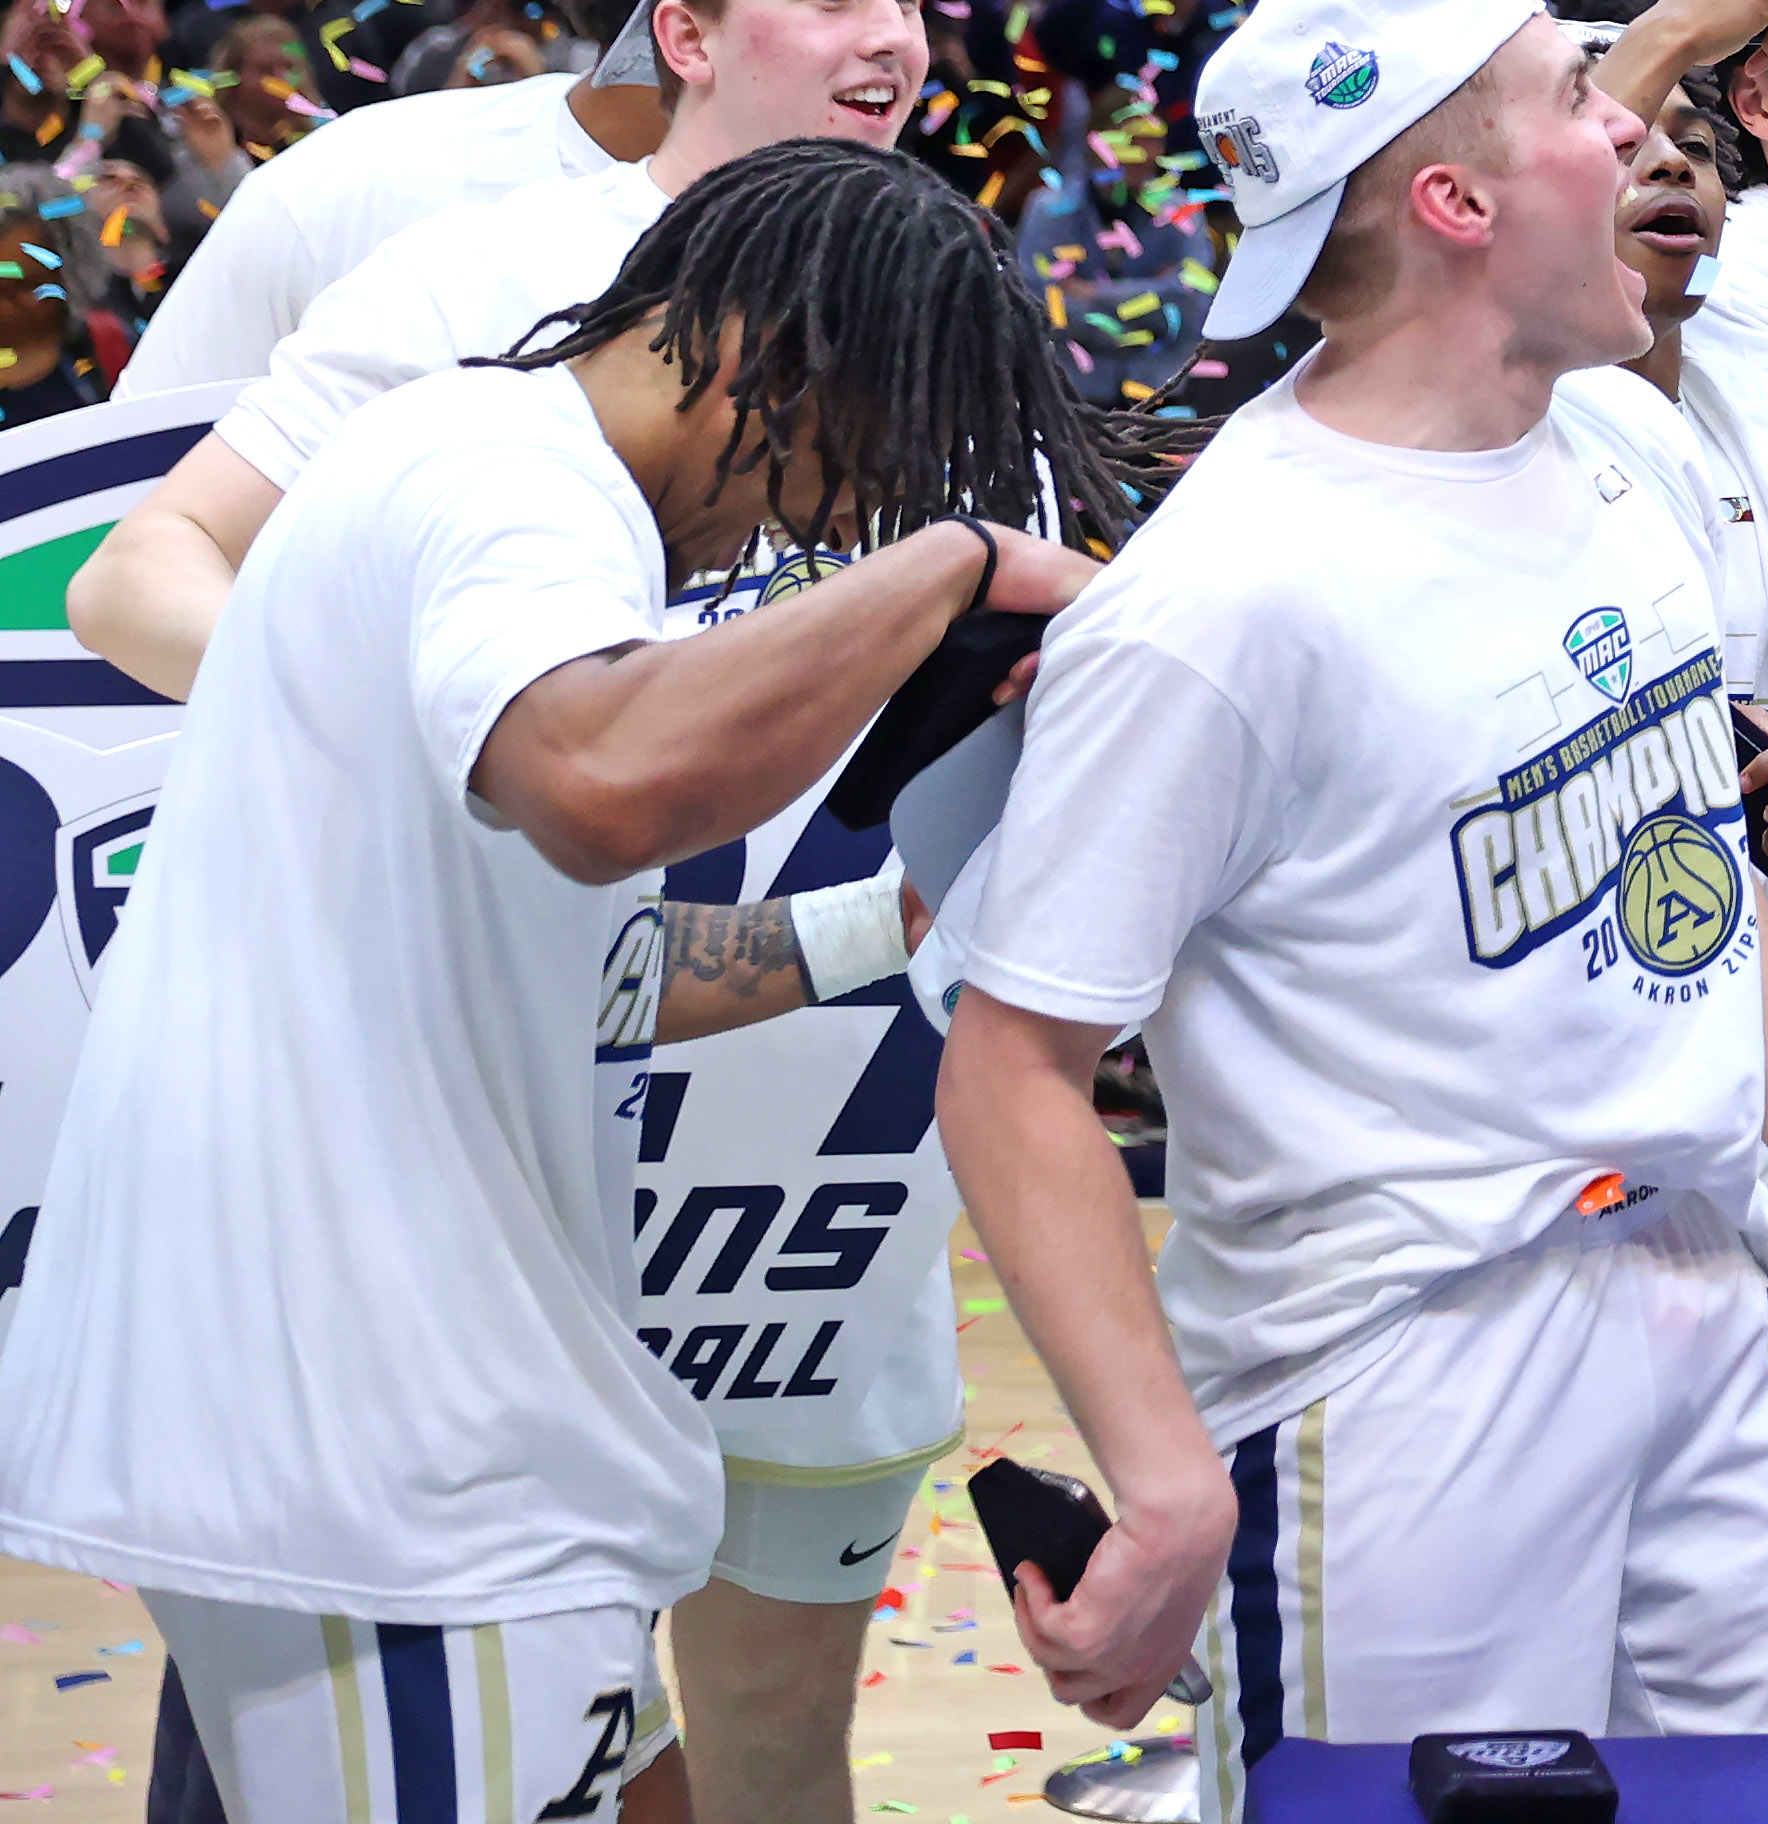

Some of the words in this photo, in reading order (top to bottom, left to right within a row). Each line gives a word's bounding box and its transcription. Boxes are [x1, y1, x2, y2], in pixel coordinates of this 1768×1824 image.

[1576, 635, 1631, 676] MAC
[1506, 761, 1559, 803] MEN'S
[1560, 704, 1646, 774] BASKETBALL
[1656, 889, 1715, 949] A
[1632, 973, 1710, 1006] AKRON
